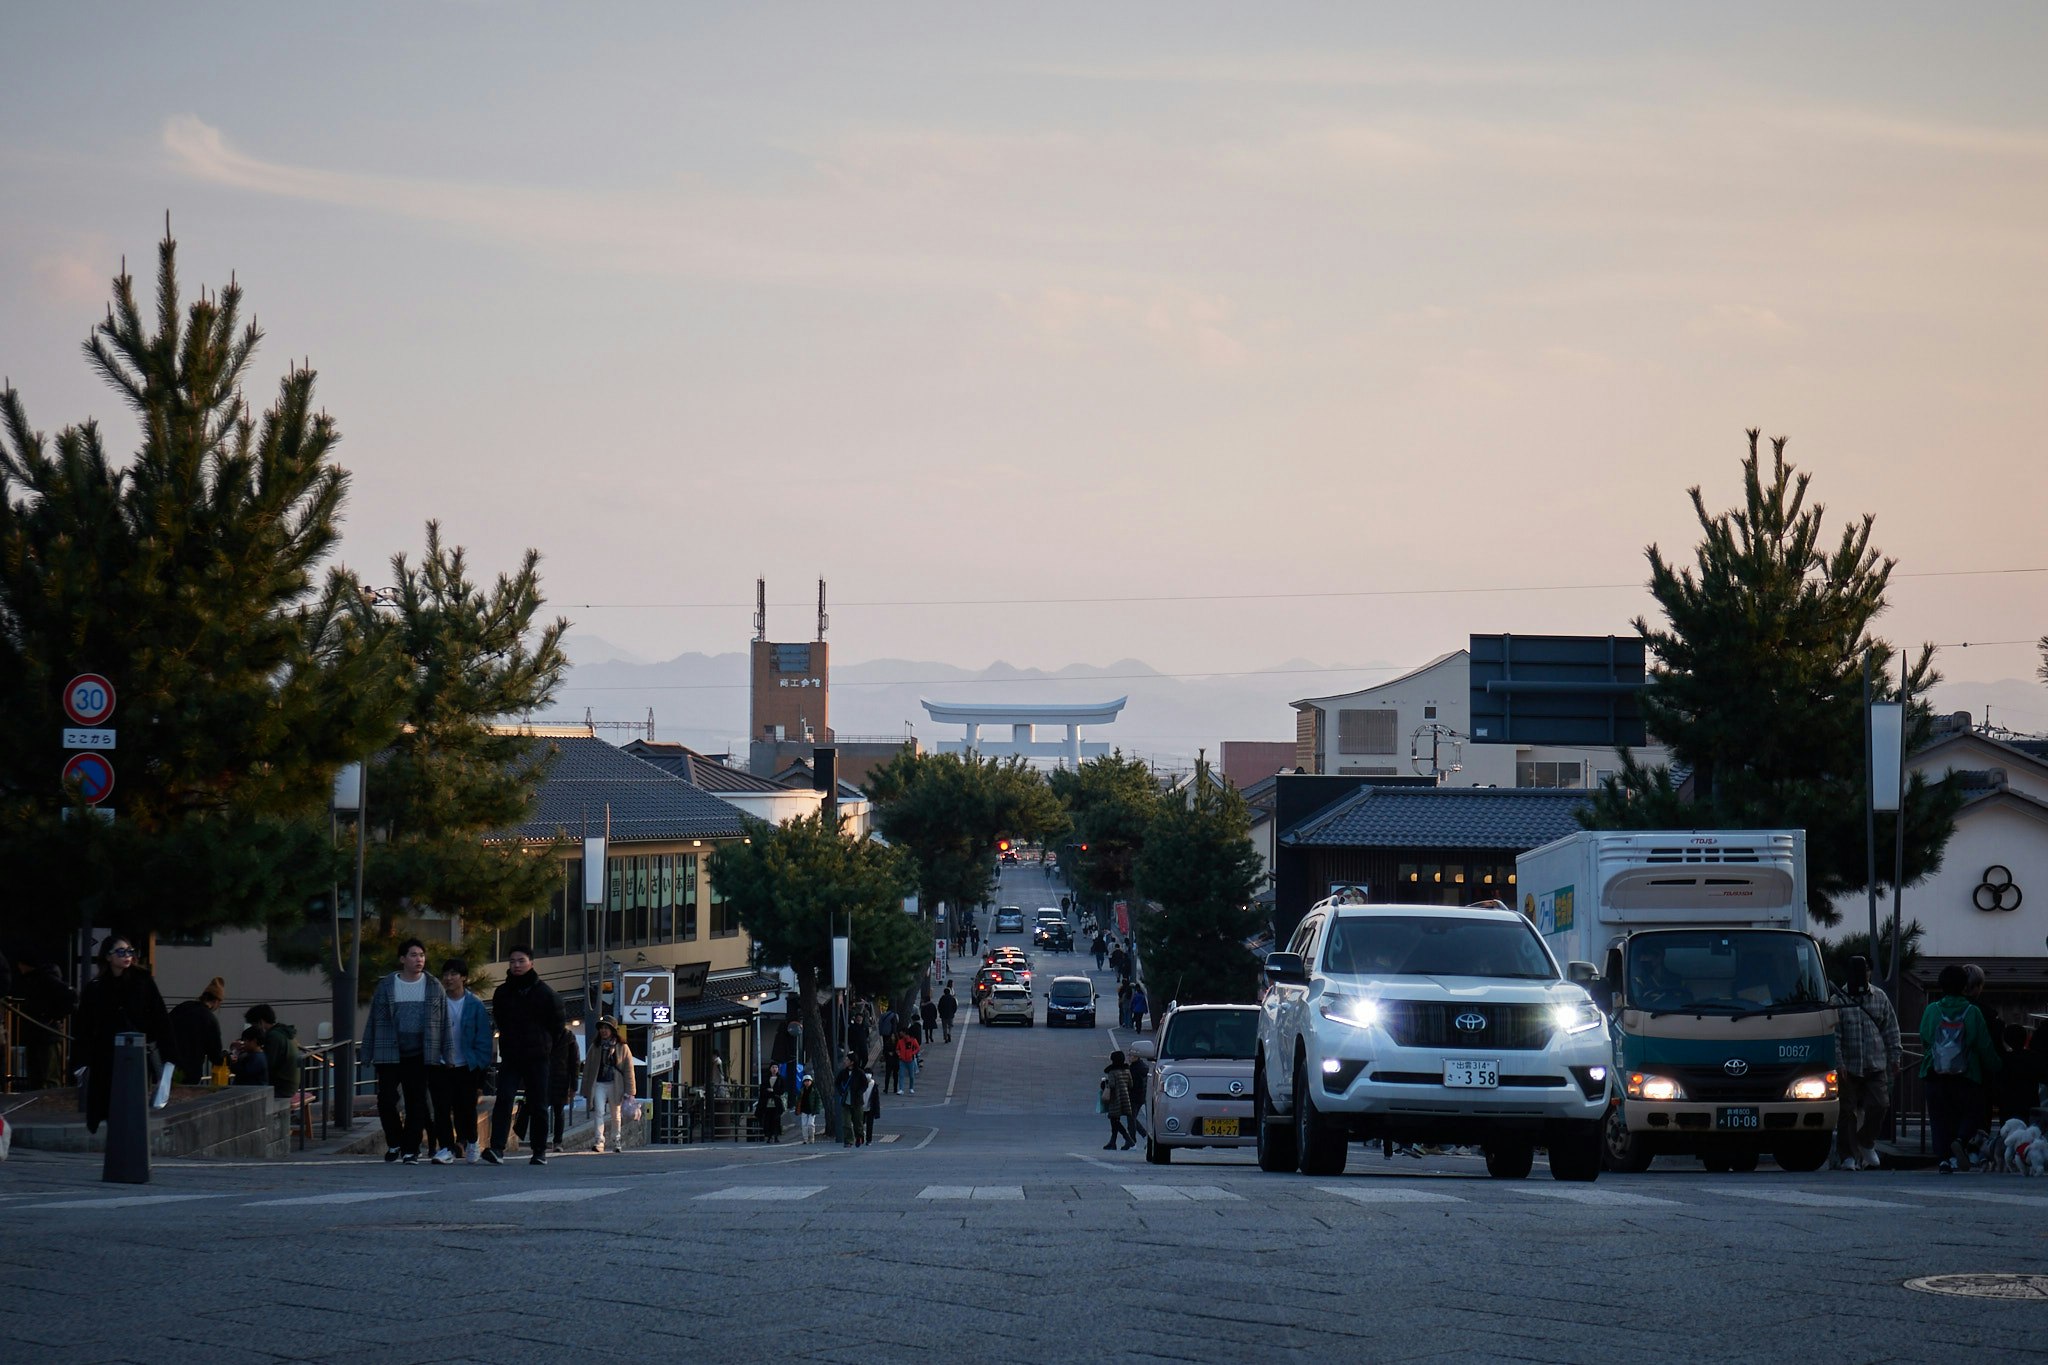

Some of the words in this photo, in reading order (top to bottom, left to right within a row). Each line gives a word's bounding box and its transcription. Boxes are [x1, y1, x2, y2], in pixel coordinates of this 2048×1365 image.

[75, 688, 104, 711] 30
[67, 734, 112, 744] ここから
[612, 873, 695, 898] 雲ぜんざい本舗
[653, 1006, 670, 1023] 空
[1779, 1045, 1810, 1057] D0627
[1727, 1115, 1757, 1127] 10-08
[1210, 1125, 1238, 1135] 94-27
